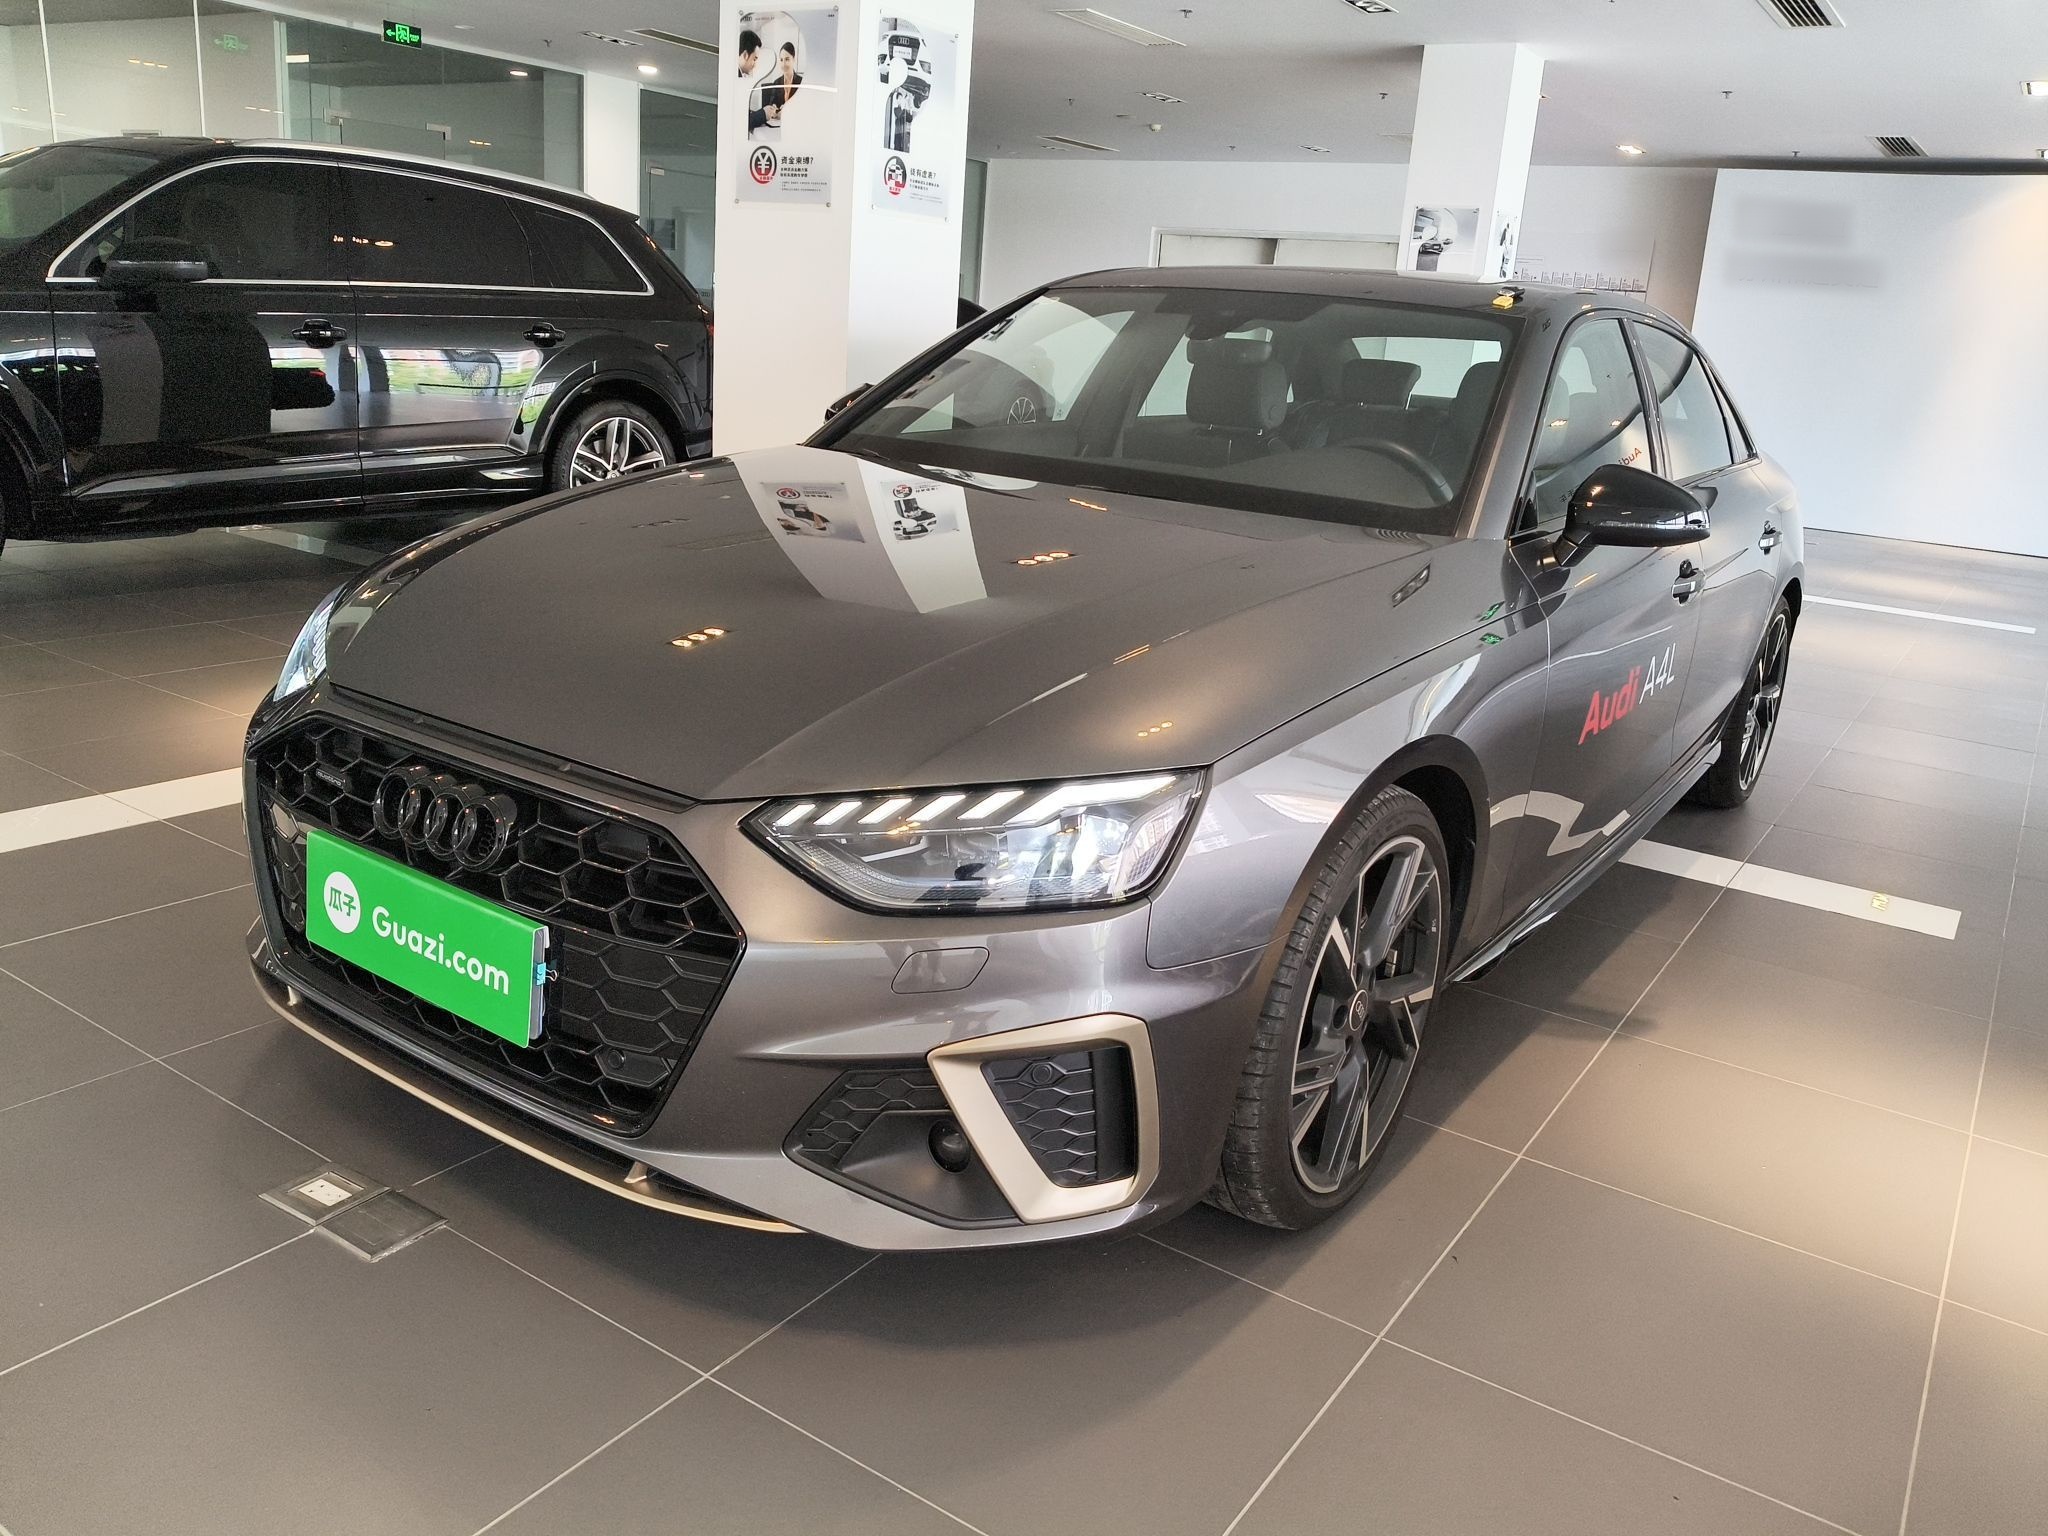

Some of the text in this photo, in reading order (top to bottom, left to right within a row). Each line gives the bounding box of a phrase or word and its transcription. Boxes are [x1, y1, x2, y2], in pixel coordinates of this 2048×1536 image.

[1578, 642, 1676, 745] Audi A4L
[328, 886, 357, 917] 瓜子
[371, 905, 510, 995] Guazi.com
